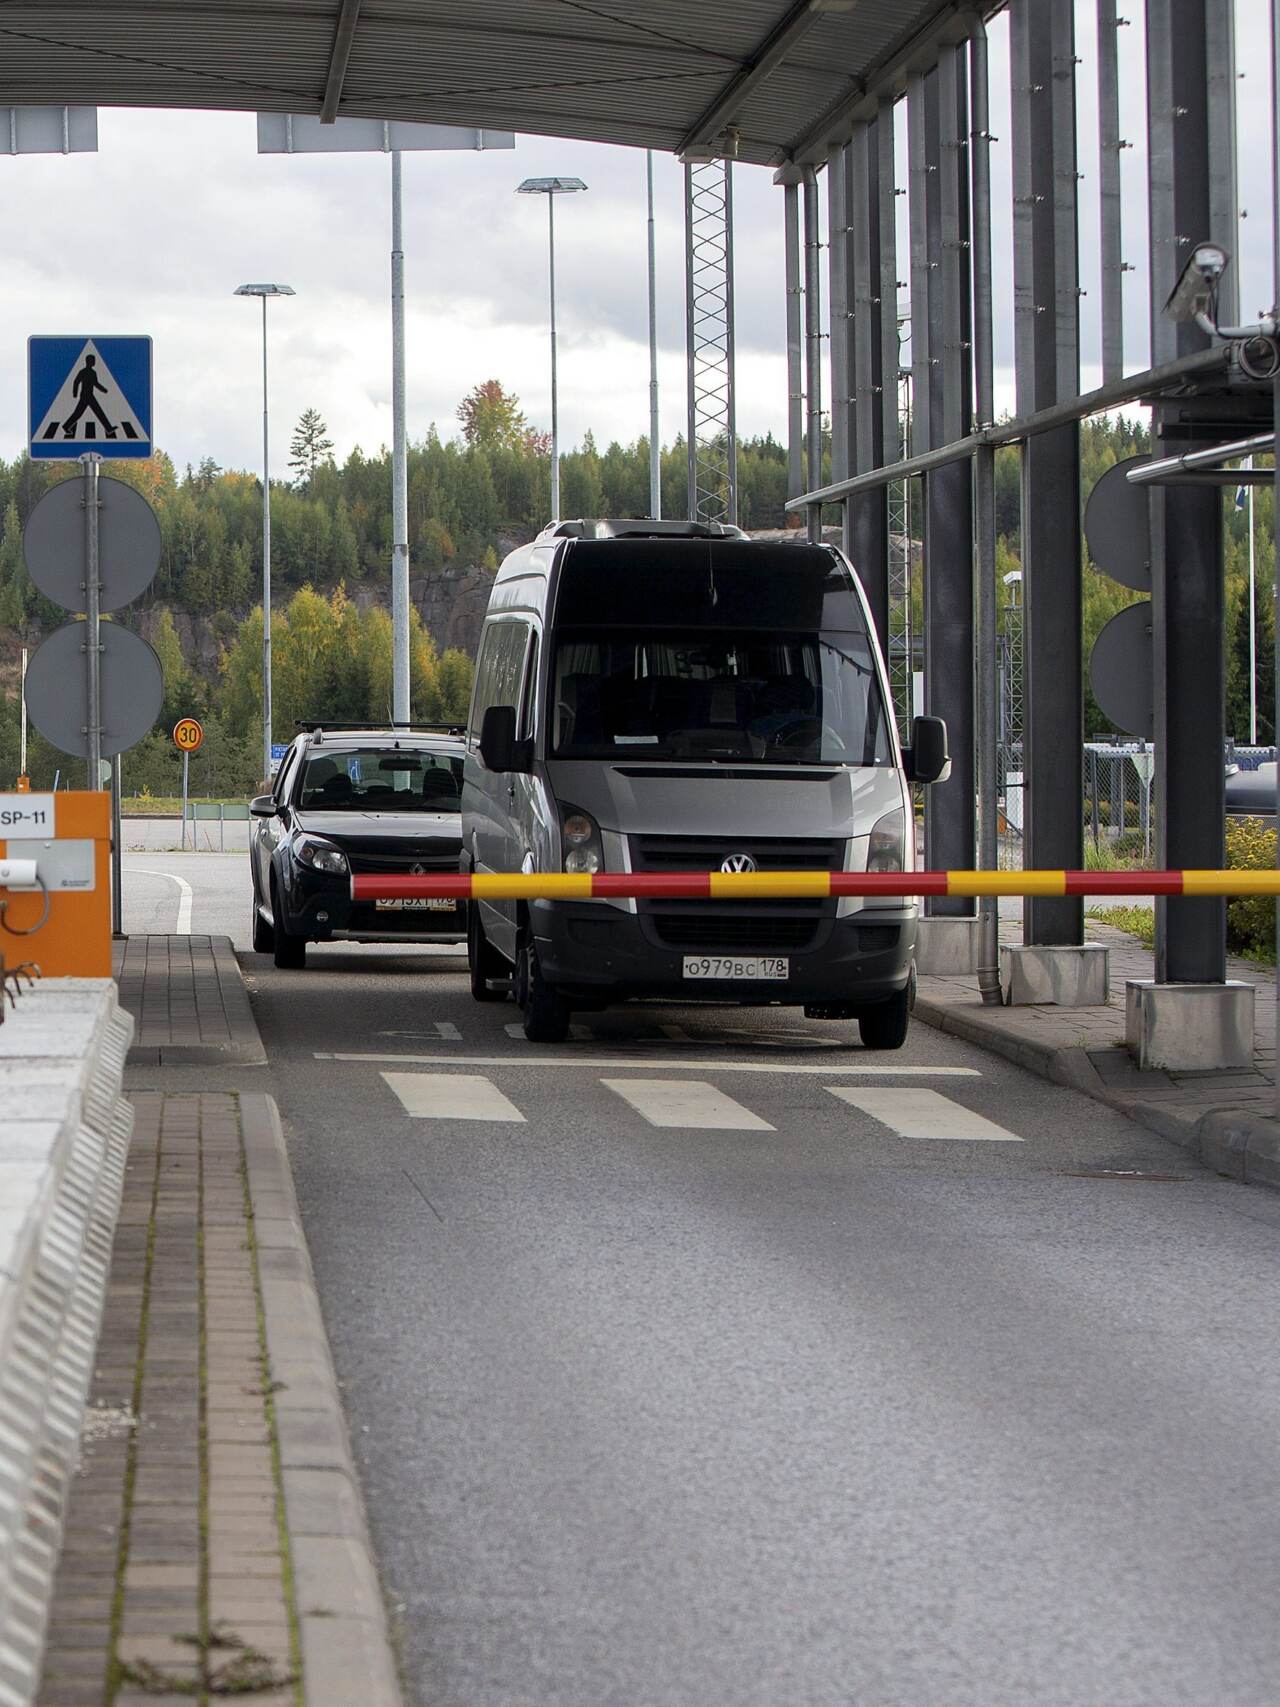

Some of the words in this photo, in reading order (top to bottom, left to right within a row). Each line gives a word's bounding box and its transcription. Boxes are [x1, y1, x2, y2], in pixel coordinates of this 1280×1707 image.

[180, 727, 197, 743] 30
[1, 811, 46, 825] SP-11
[760, 959, 784, 972] 178
